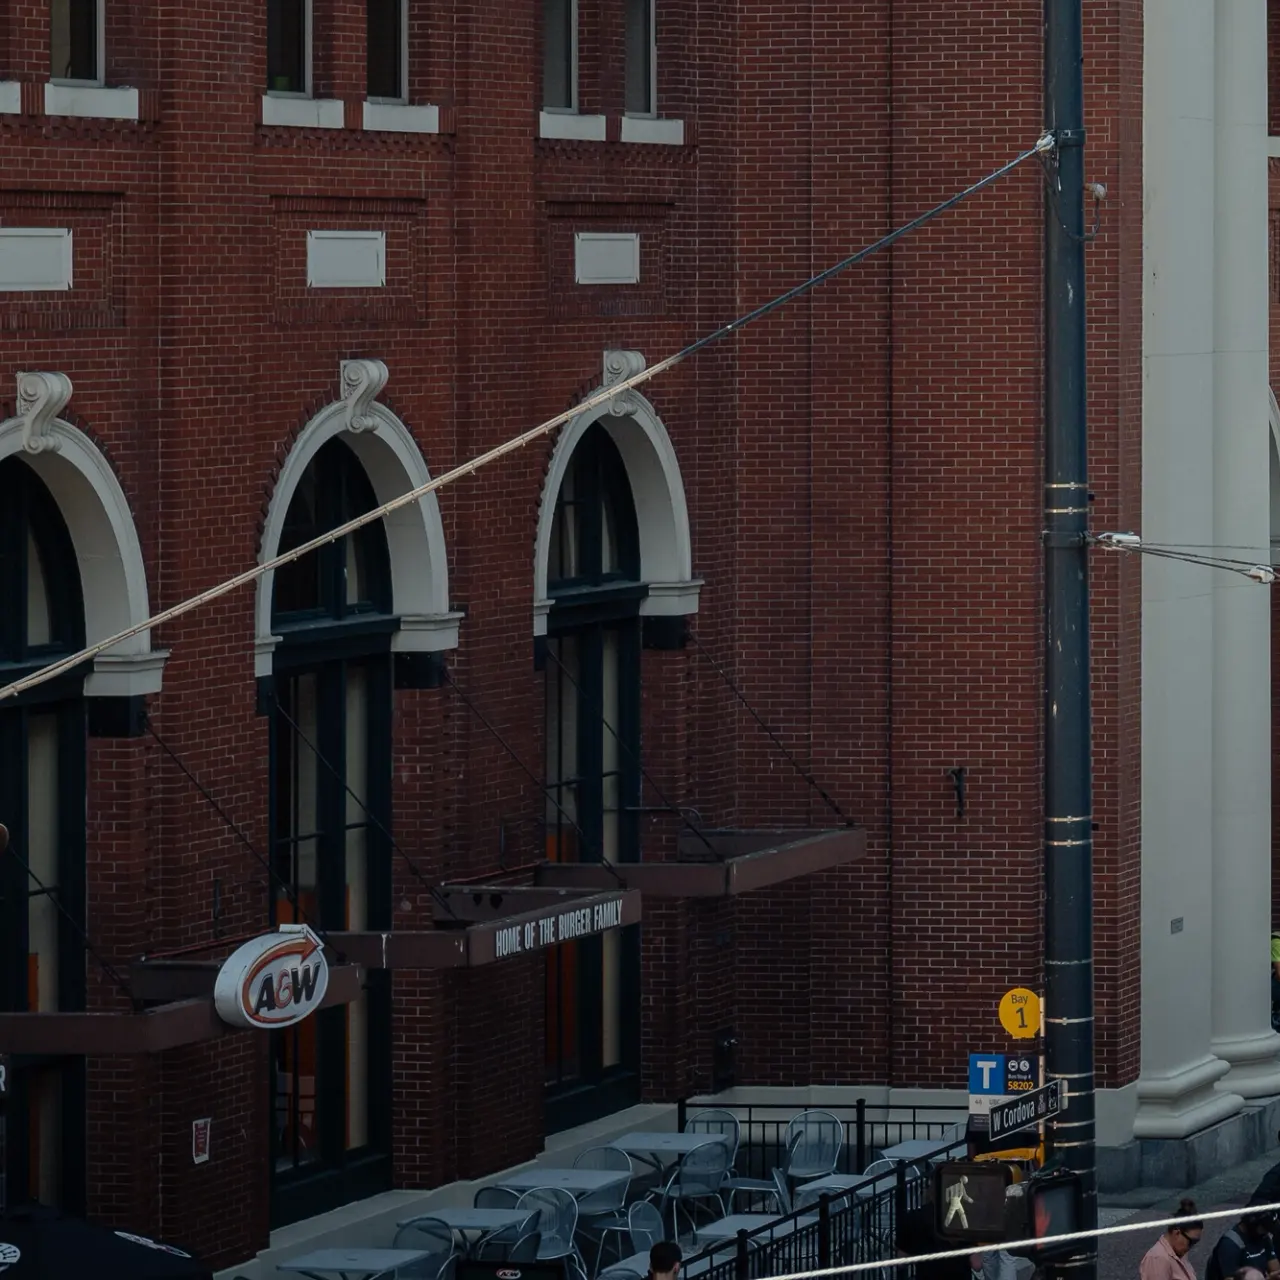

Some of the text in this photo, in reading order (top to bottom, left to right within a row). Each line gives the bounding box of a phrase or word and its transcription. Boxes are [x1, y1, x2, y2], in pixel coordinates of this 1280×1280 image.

[496, 899, 623, 957] HOME OF THE BURGER FAMILY
[254, 963, 321, 1014] A&W
[1011, 994, 1028, 1005] Bay
[1016, 1007, 1028, 1029] 1
[977, 1061, 997, 1089] T
[1008, 1081, 1034, 1091] 58202
[993, 1111, 1001, 1132] W
[1003, 1100, 1035, 1128] Cordova
